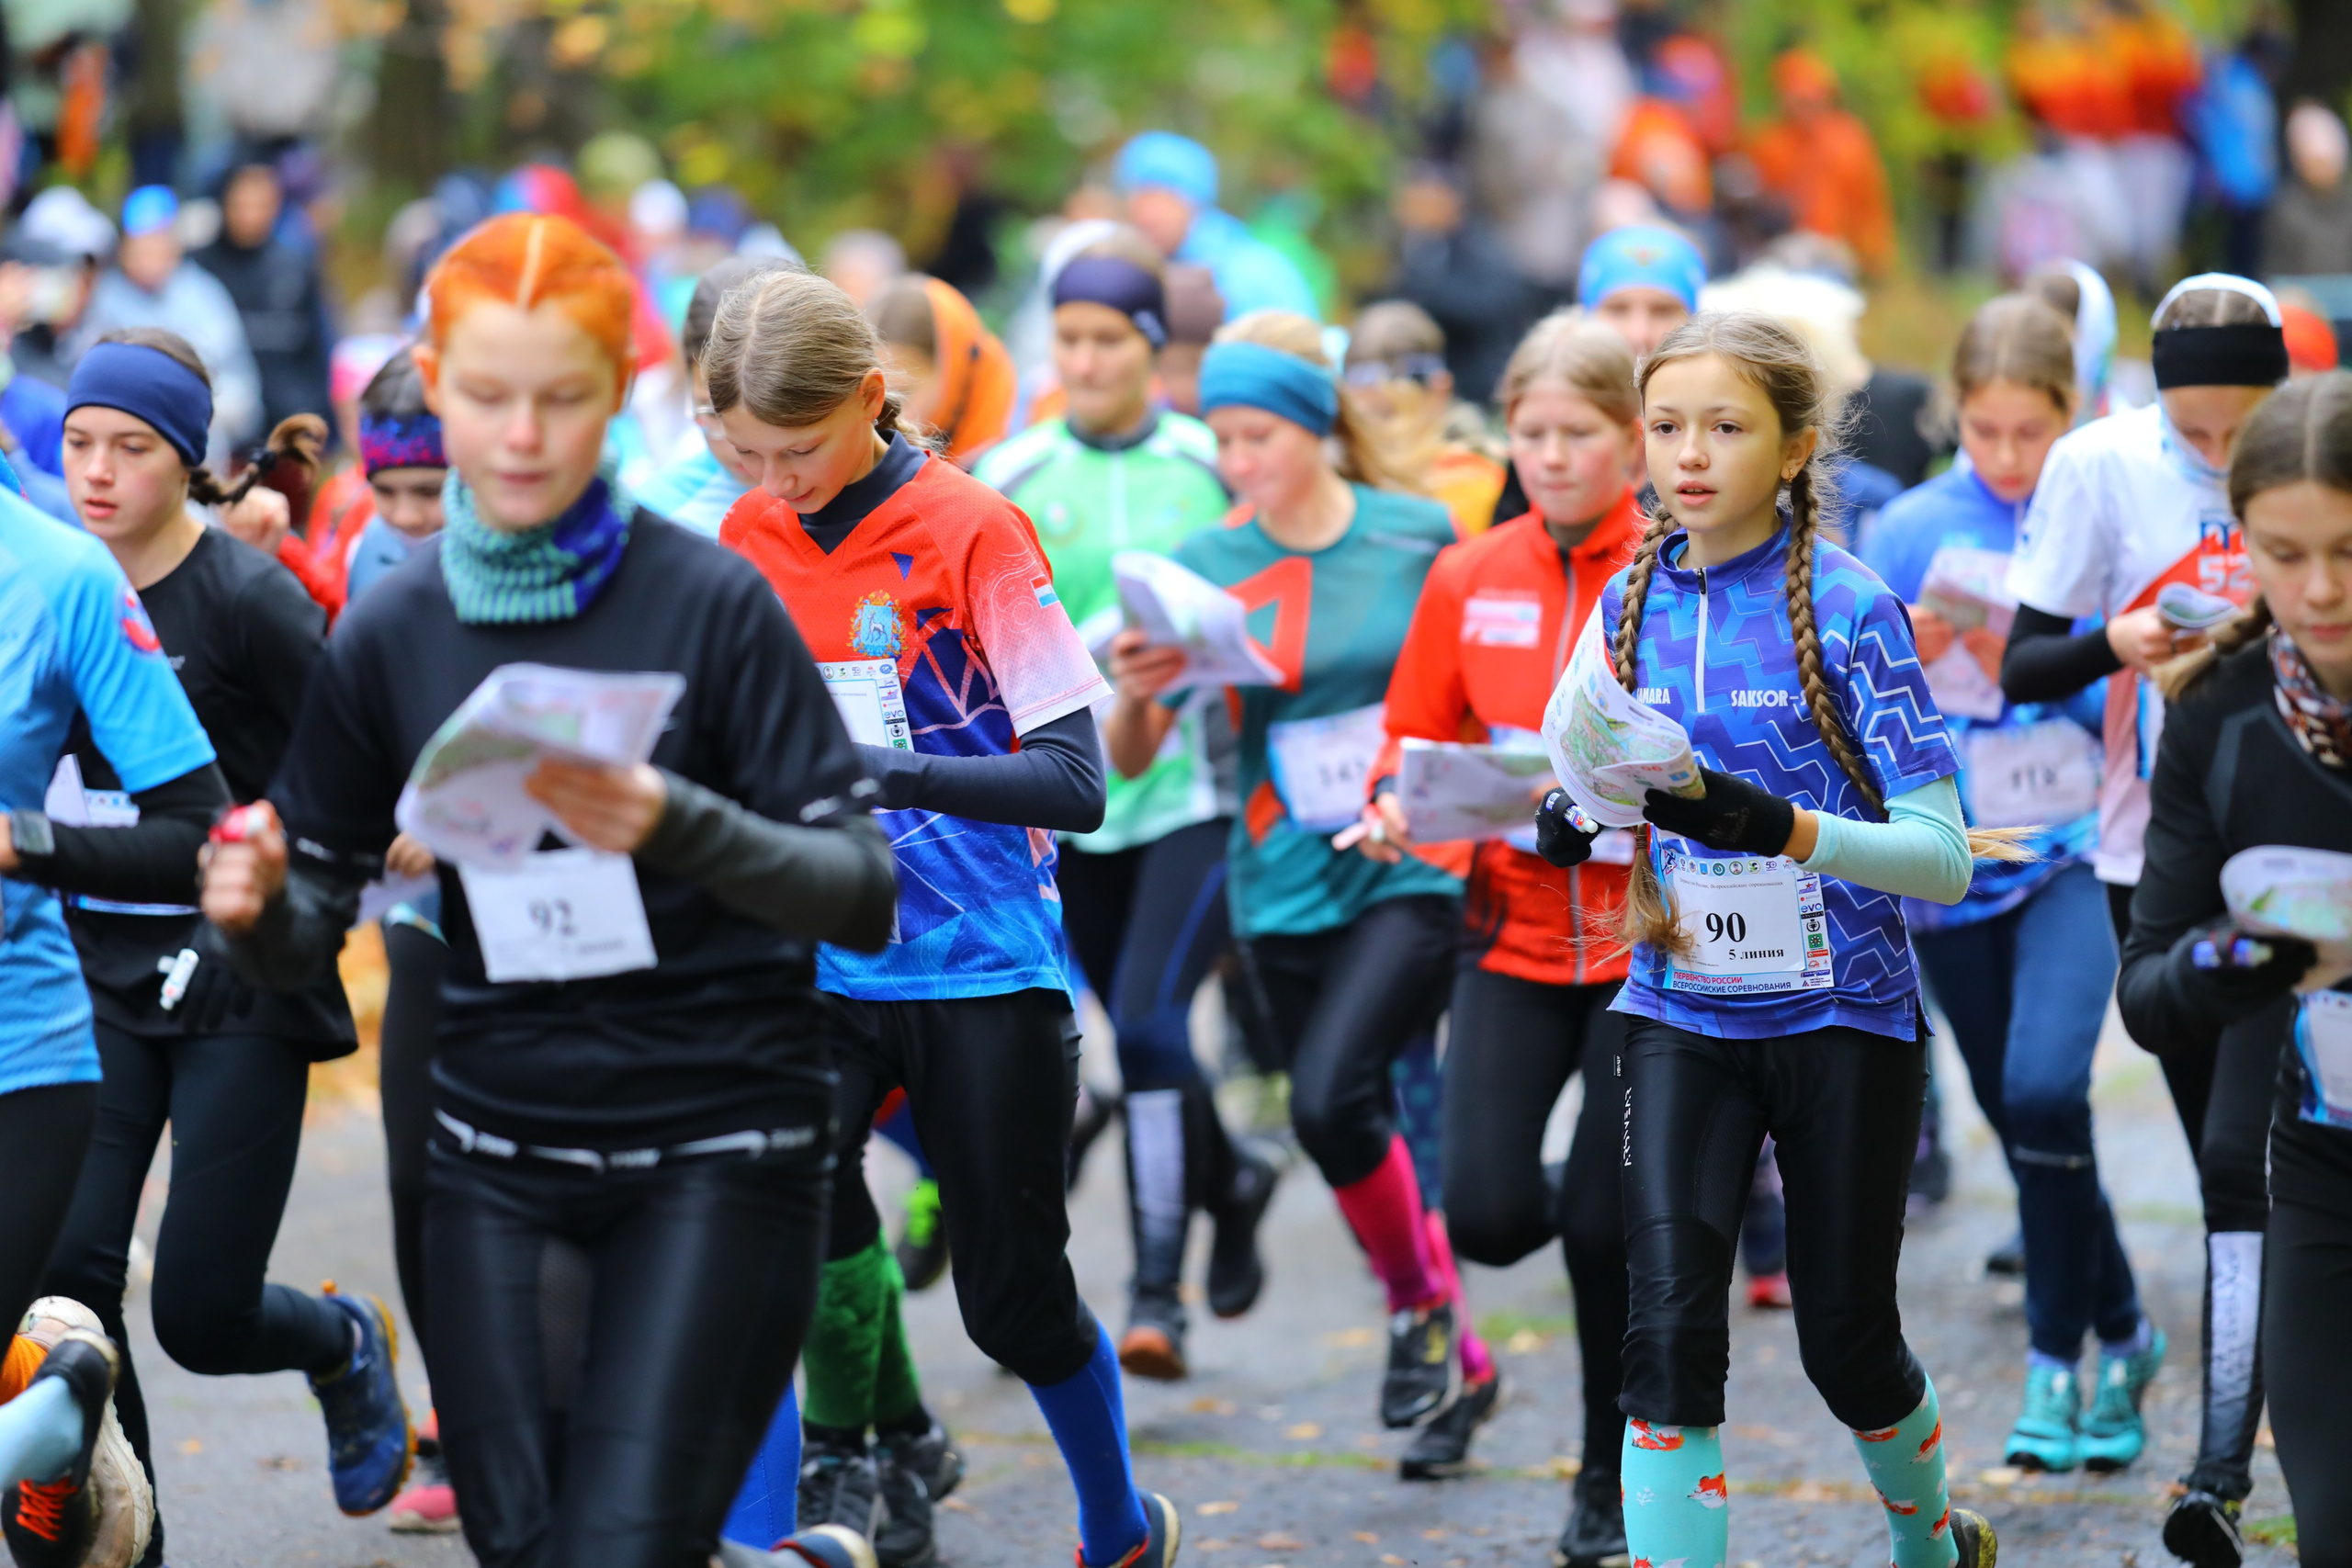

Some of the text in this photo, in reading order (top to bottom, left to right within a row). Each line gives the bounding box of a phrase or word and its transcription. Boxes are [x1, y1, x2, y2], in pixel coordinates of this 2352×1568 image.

[1801, 902, 1823, 913] evo
[528, 897, 579, 937] 92
[1705, 912, 1747, 943] 90
[1728, 949, 1784, 960] 5 линия
[1674, 971, 1743, 985] ПЕРВЕНСТВО РОССИИ
[1727, 981, 1792, 993] СОРЕВНОВАНИЯ
